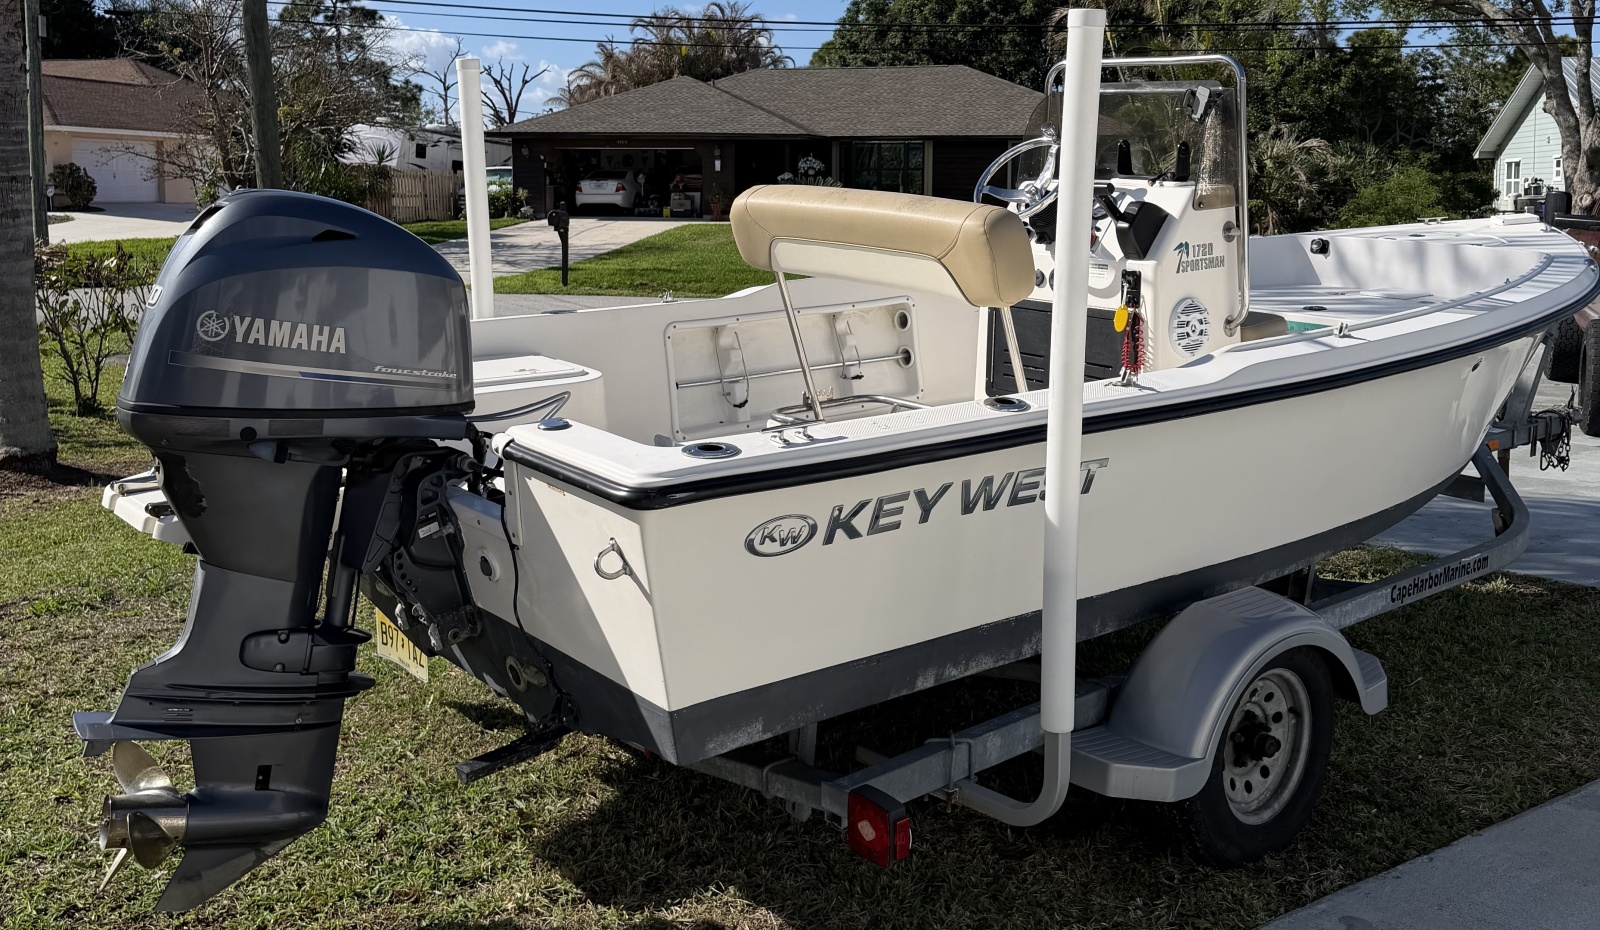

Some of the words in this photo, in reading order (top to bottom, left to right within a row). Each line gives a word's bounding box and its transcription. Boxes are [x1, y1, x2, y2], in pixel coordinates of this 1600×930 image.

[1192, 242, 1214, 258] 1720
[1181, 255, 1225, 273] SPORTSMAN
[233, 315, 346, 354] YAMAHA
[374, 365, 457, 379] fourstroke
[822, 481, 954, 546] KEY
[960, 457, 1110, 516] WET
[758, 524, 807, 547] KW
[1390, 555, 1489, 604] CapeHarborMarine.com
[380, 621, 399, 652] B97
